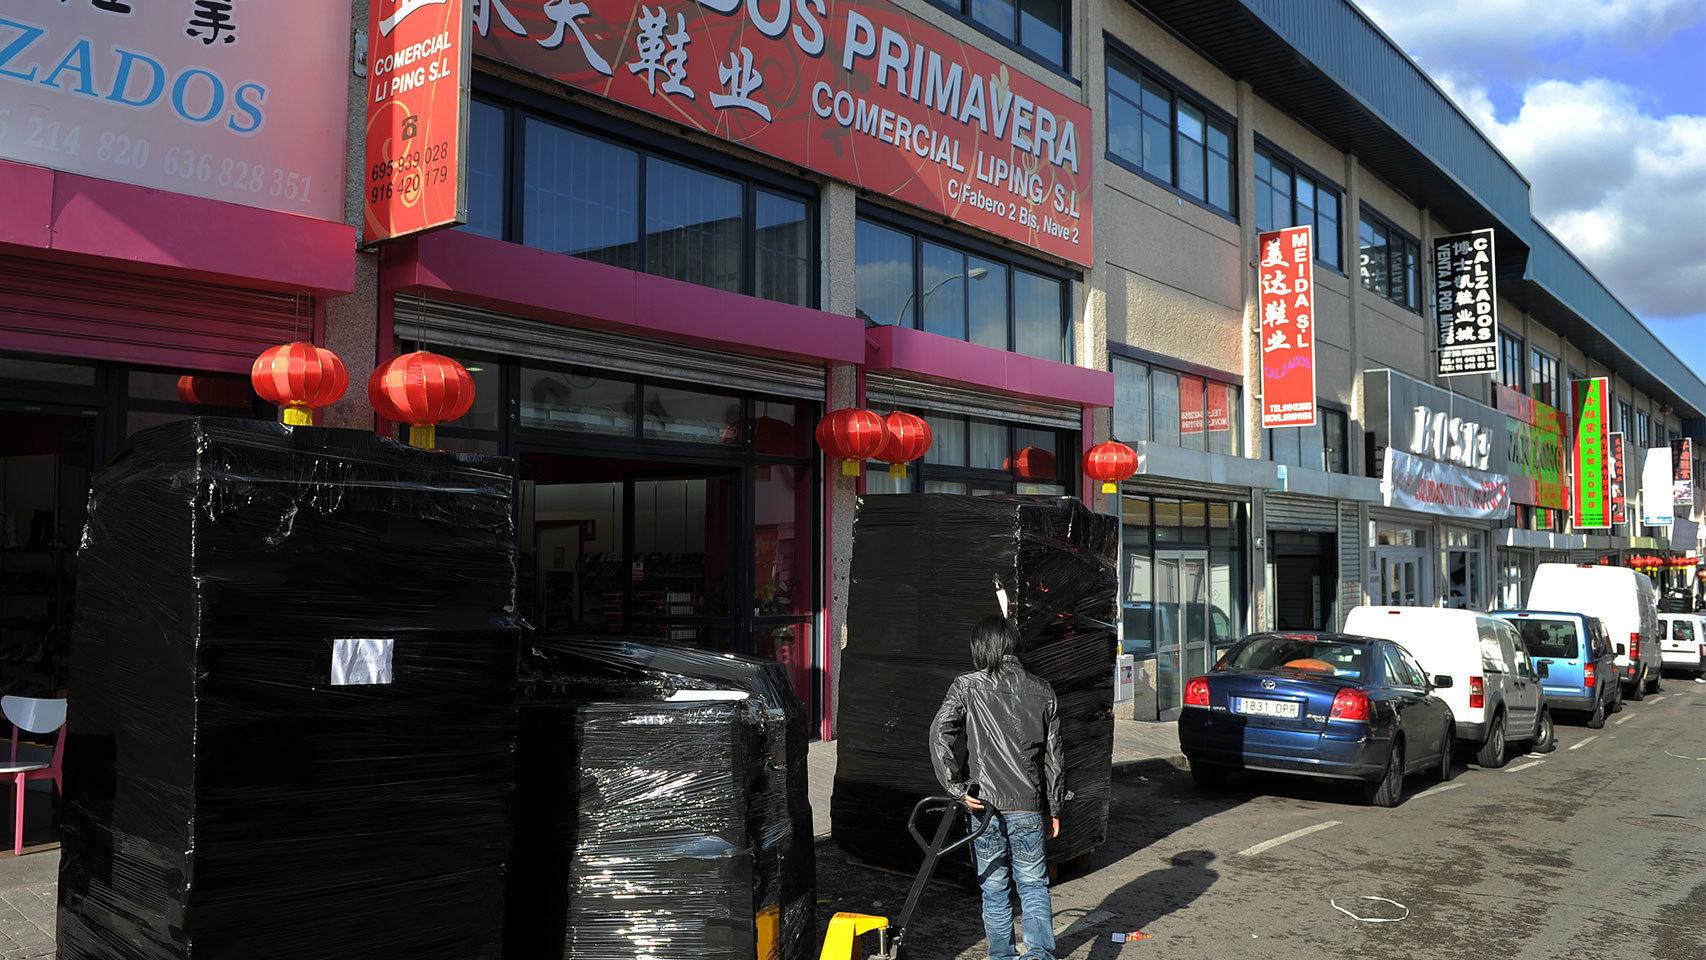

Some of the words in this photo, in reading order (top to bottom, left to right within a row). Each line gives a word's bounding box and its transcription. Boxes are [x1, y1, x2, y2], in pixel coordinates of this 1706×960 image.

[374, 31, 453, 76] COMERCIAL
[375, 82, 387, 103] LI
[390, 70, 427, 97] PING
[428, 62, 451, 83] S.L
[842, 9, 1079, 173] PRIMAVERA
[96, 131, 150, 170] 820
[162, 145, 213, 184] 636
[217, 157, 265, 193] 828
[270, 167, 313, 204] 351
[371, 160, 393, 182] 695
[398, 151, 420, 173] 939
[424, 142, 448, 165] 028
[811, 80, 966, 173] COMERCIAL
[976, 150, 1044, 206] LIPING
[1053, 183, 1081, 219] S.L
[371, 182, 393, 204] 916
[397, 174, 420, 196] 420
[425, 165, 448, 187] 179
[947, 178, 1006, 217] C/Fabero
[1008, 203, 1017, 222] 2
[1043, 214, 1070, 240] Nave
[1071, 228, 1080, 244] 2
[1291, 232, 1310, 309] MEIDA
[1437, 243, 1452, 278] VENTA
[1260, 237, 1292, 353] 美达鞋业
[1439, 290, 1453, 312] POR
[1473, 237, 1493, 341] CALZADOS
[1264, 355, 1311, 381] CALZADOS
[1585, 437, 1596, 465] WAN
[1600, 422, 1610, 502] CALZADOS
[1588, 471, 1597, 509] LONG
[1245, 700, 1269, 712] 1831
[1275, 703, 1296, 715] DPR
